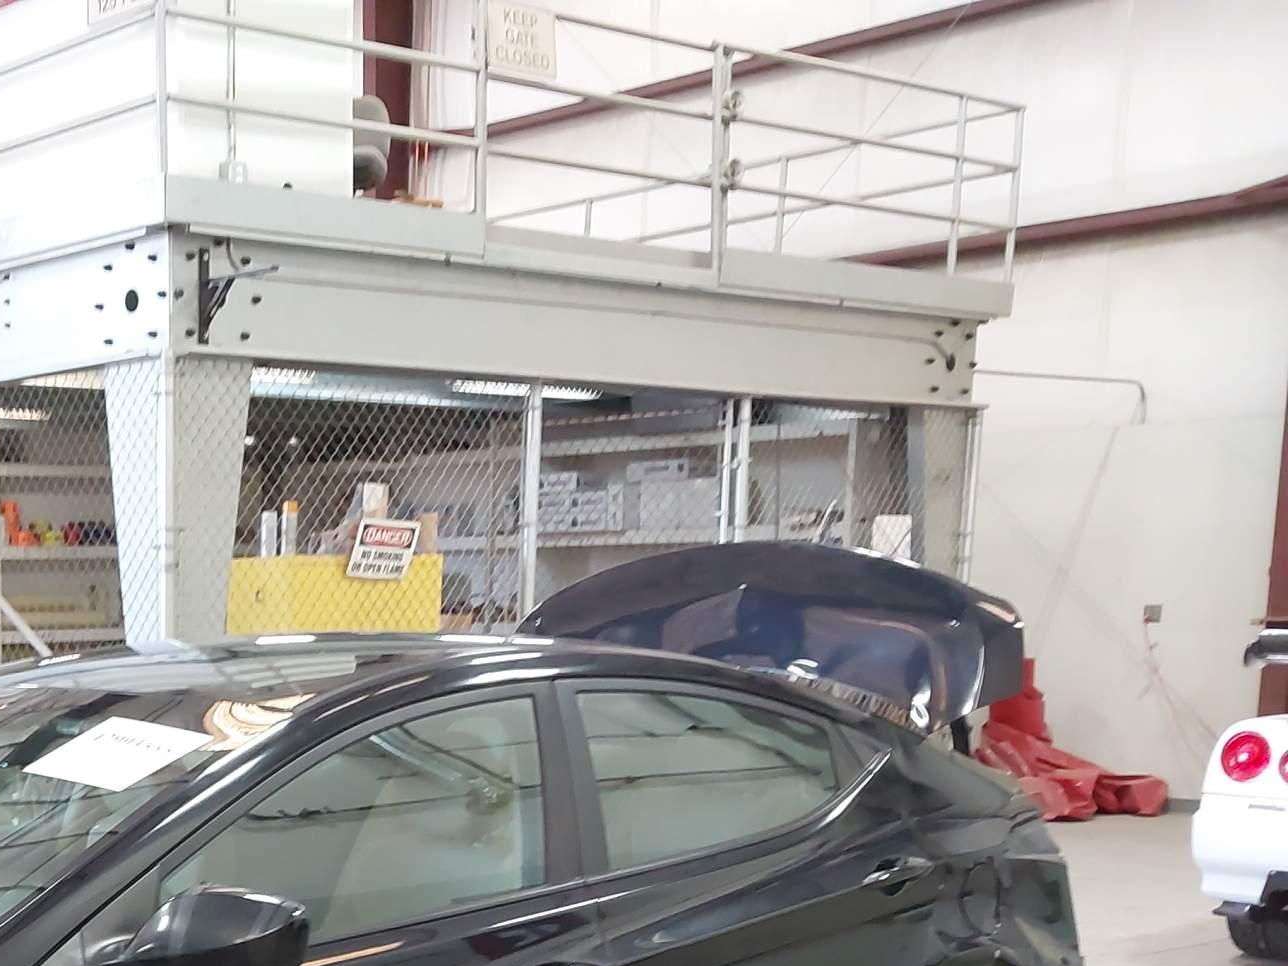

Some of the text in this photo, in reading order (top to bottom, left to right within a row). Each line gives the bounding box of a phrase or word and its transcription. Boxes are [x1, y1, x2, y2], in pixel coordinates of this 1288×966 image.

[504, 7, 538, 27] KEEP
[505, 28, 537, 47] GATE
[495, 45, 550, 69] CLOSED
[366, 527, 411, 546] DANGER
[361, 550, 404, 561] NO SMOKING
[351, 561, 362, 572] OR
[363, 562, 382, 573] OPEN
